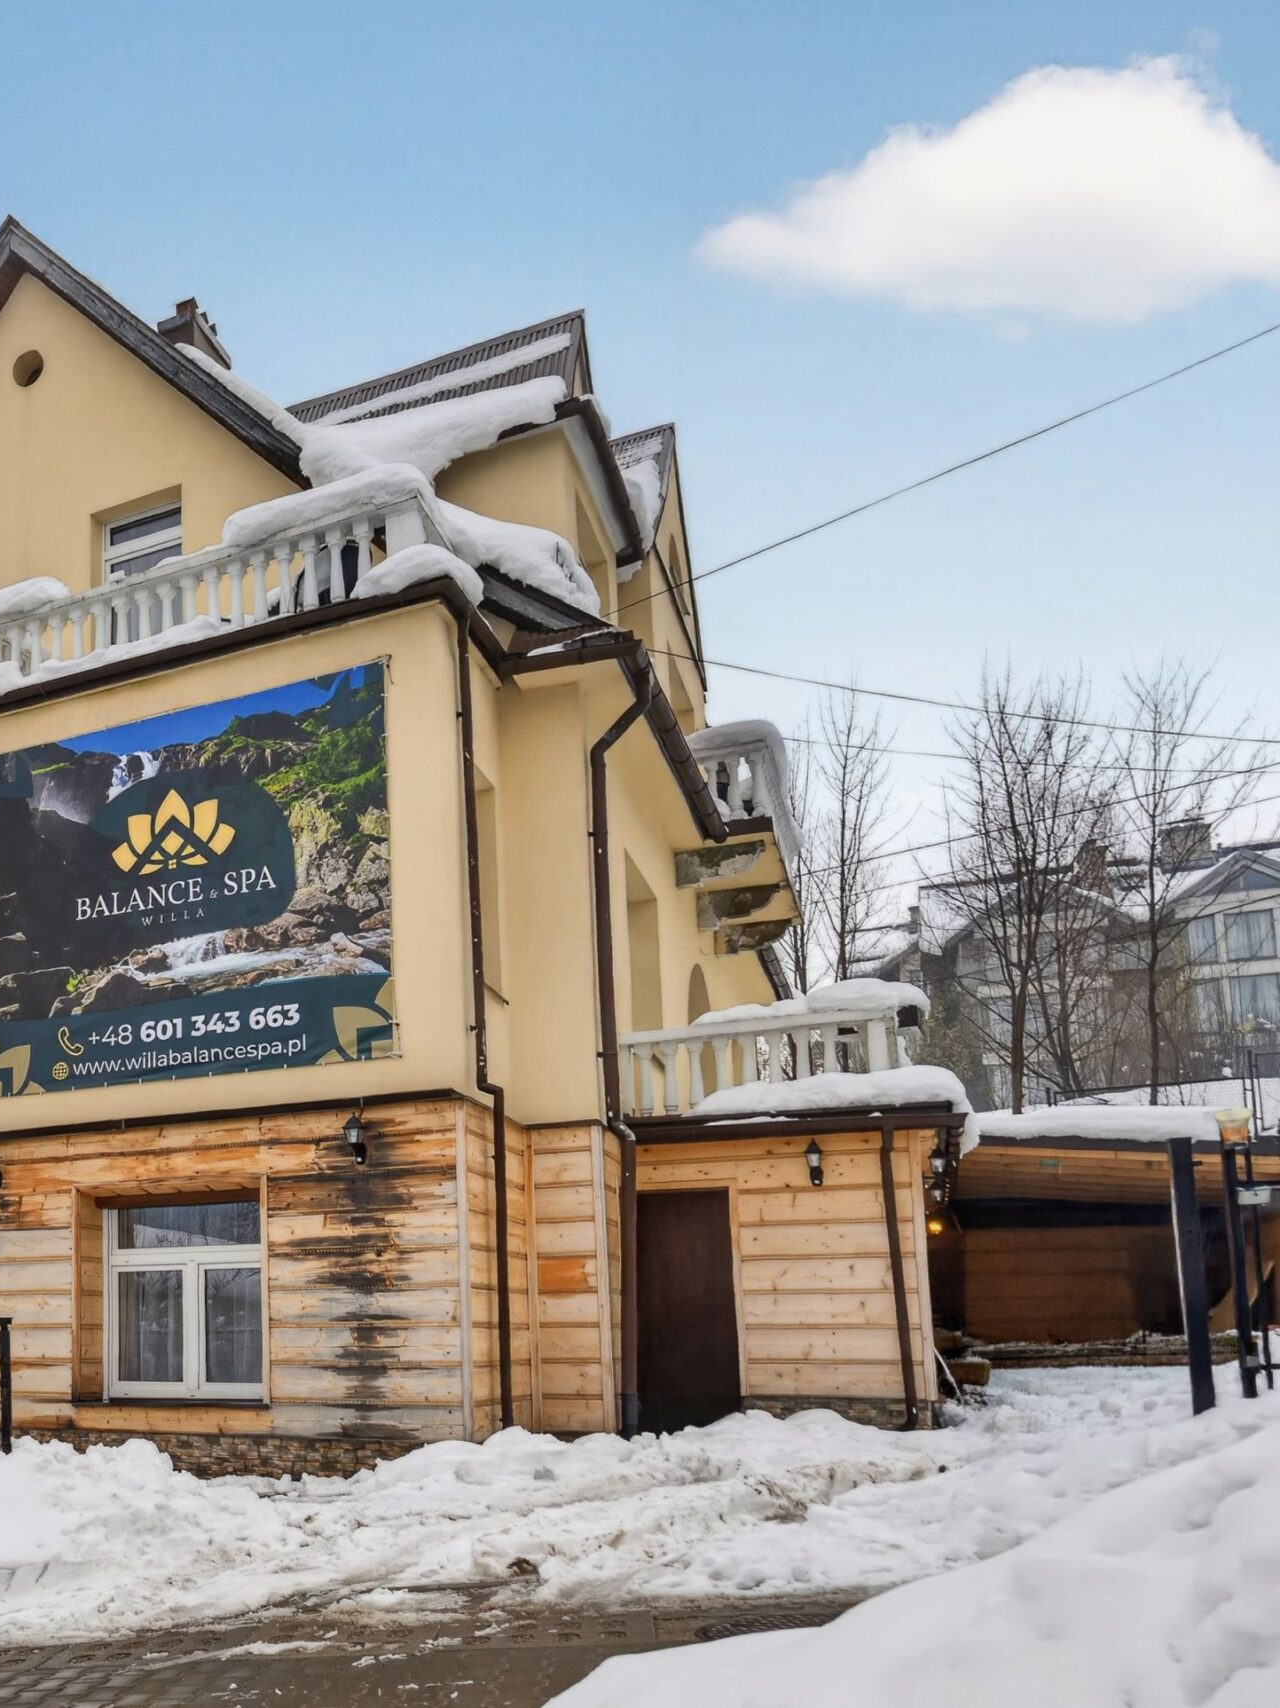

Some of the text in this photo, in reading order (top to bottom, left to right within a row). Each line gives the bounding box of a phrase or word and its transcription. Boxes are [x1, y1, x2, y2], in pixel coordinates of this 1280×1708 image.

[76, 865, 277, 922] BALANCE & SPA
[141, 909, 205, 927] WILLA
[88, 1003, 301, 1047] +48 601 343 663
[72, 1034, 307, 1077] www.willabalancespa.pl
